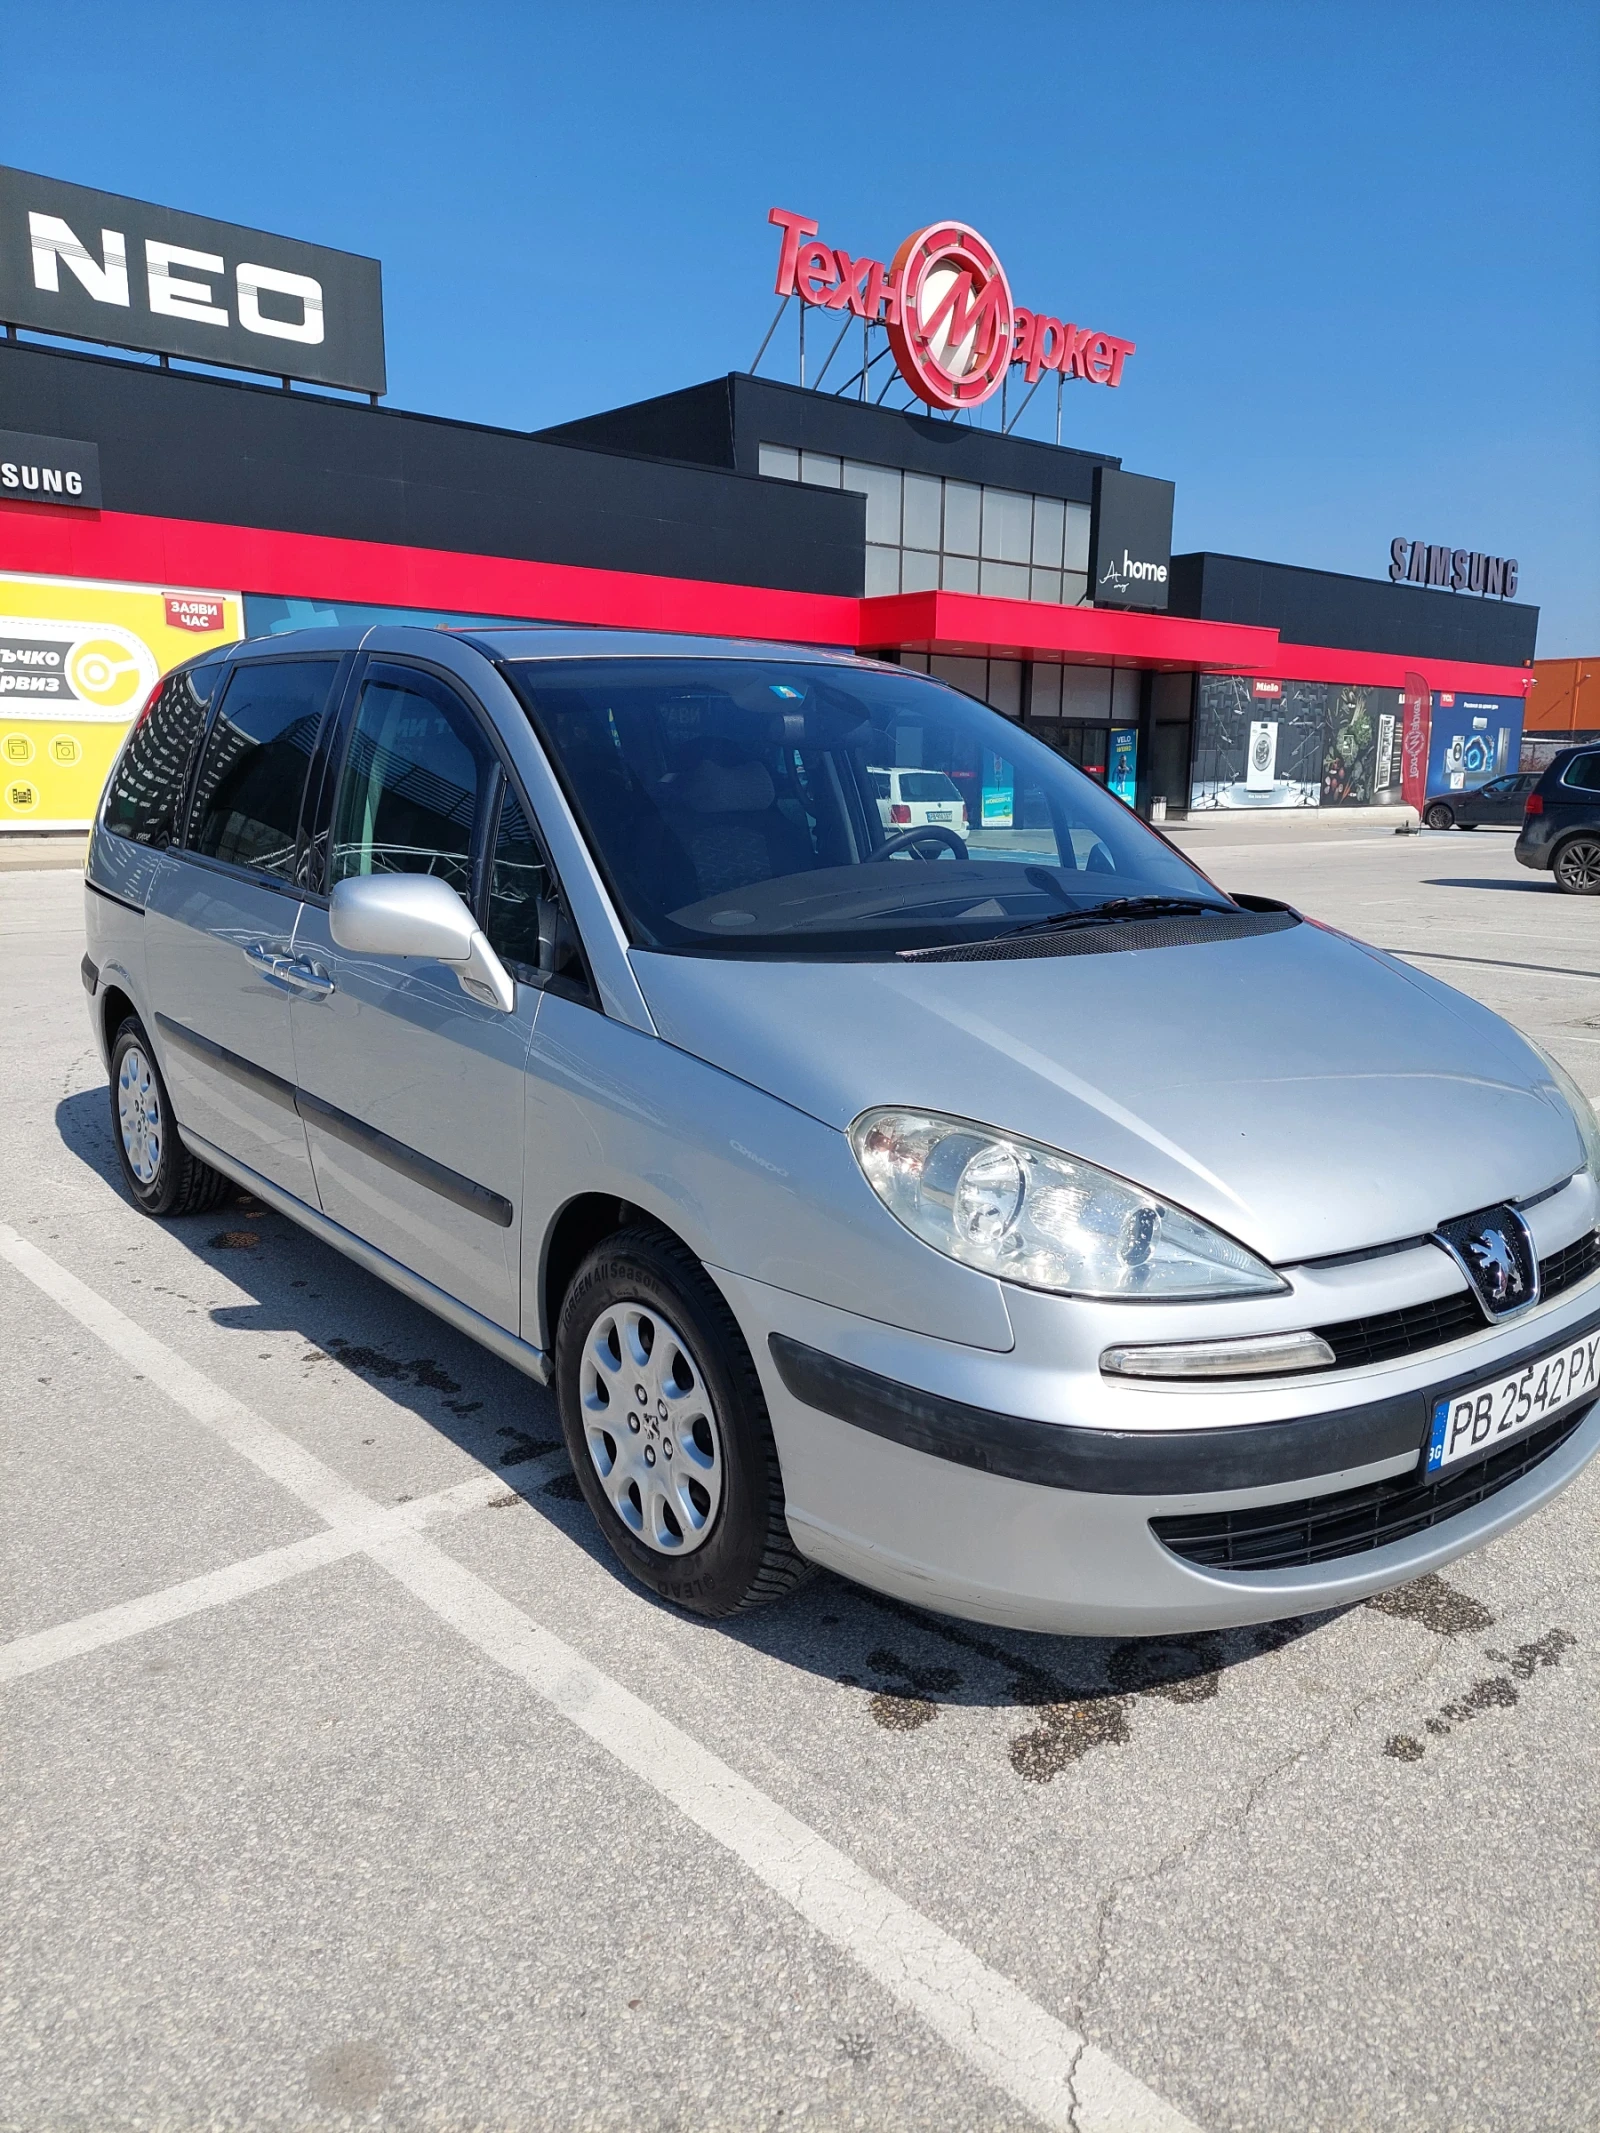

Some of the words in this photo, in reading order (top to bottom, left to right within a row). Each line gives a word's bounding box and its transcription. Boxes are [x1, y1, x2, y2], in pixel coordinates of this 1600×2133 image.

[28, 211, 324, 345] NEO
[1123, 549, 1168, 583] home
[1389, 537, 1518, 598] SAMSUNG
[171, 601, 218, 616] ЗАЯВИ
[181, 614, 209, 627] ЧАС
[1256, 682, 1279, 692] Miele
[610, 1262, 660, 1296] Season
[1449, 1393, 1493, 1455] PB
[1497, 1357, 1565, 1434] 2542
[1566, 1337, 1600, 1397] PX
